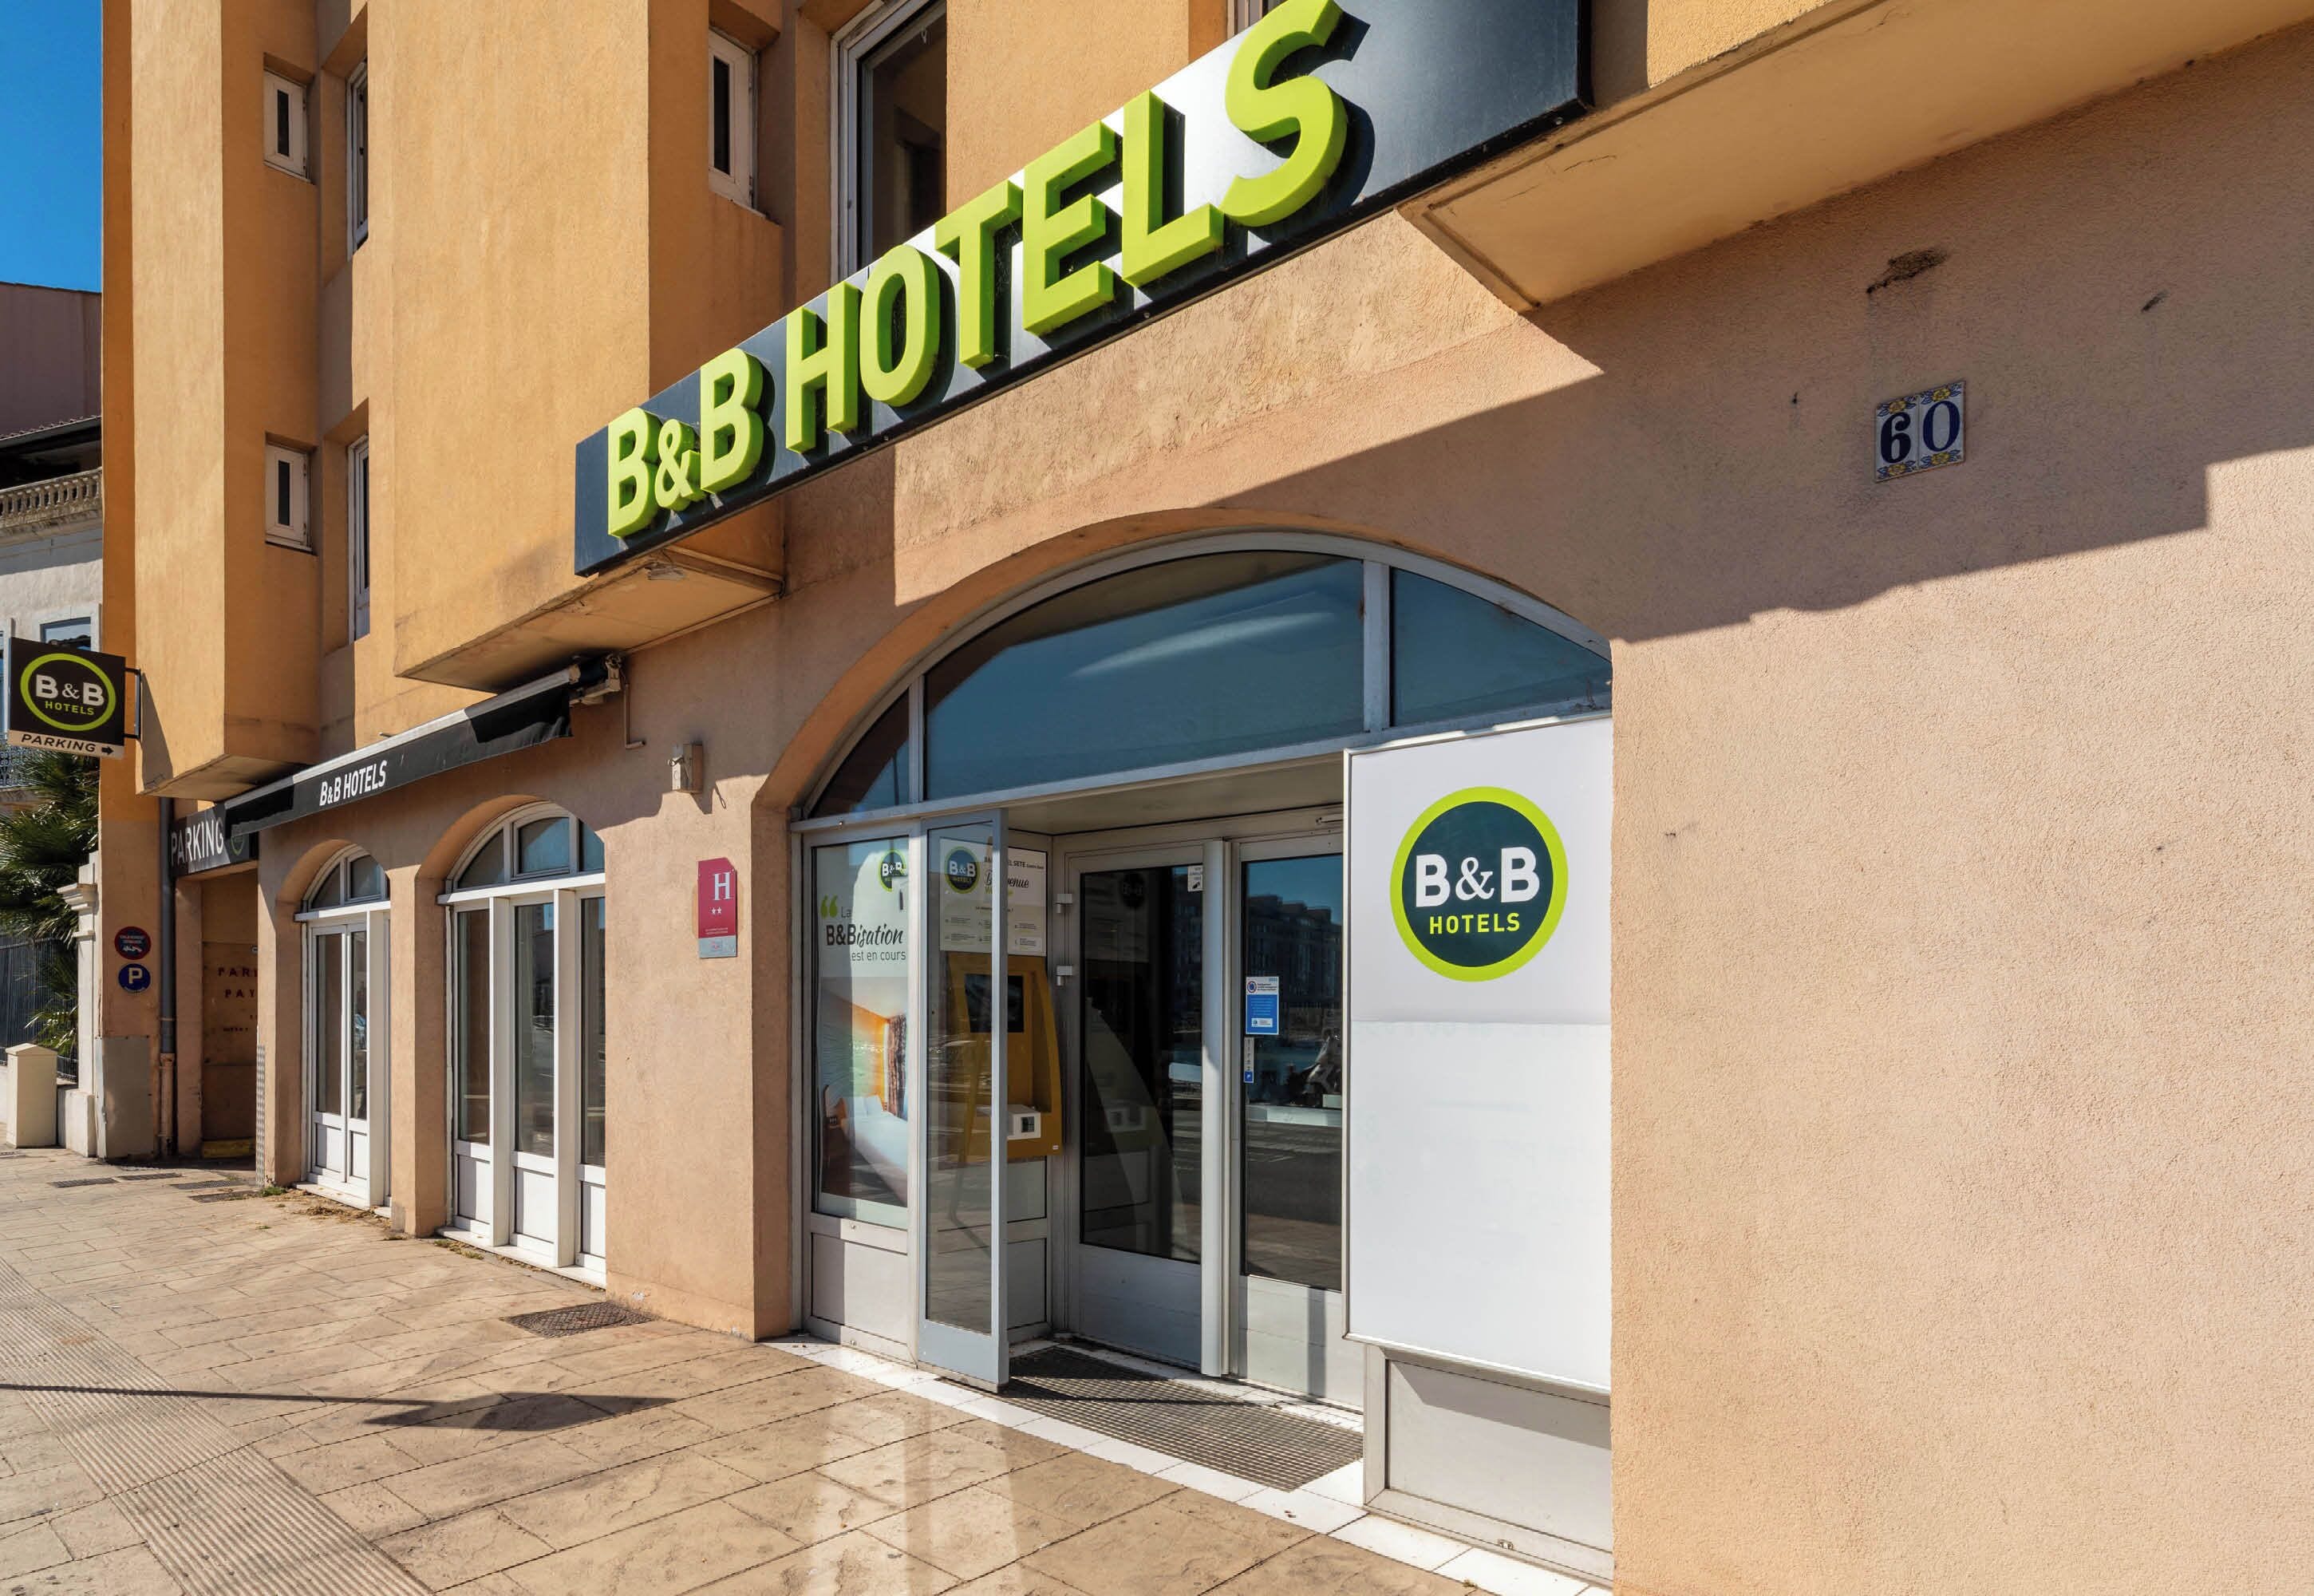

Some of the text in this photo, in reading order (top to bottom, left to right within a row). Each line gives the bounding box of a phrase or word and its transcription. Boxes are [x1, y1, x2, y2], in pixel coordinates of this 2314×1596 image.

[608, 0, 1347, 538] B&B HOTELS
[1881, 401, 1961, 463] 60
[36, 674, 105, 706] B&B
[45, 701, 95, 716] HOTELS
[21, 734, 97, 753] PARKING
[319, 760, 388, 806] B&B HOTELS
[171, 817, 223, 867] PARKING
[949, 860, 976, 878] B&B
[1416, 846, 1541, 908] B&B
[713, 871, 733, 901] H
[841, 906, 851, 918] La
[1429, 912, 1521, 934] HOTELS
[826, 923, 904, 948] B&Bisation
[851, 950, 906, 962] est en cours
[128, 967, 143, 984] P
